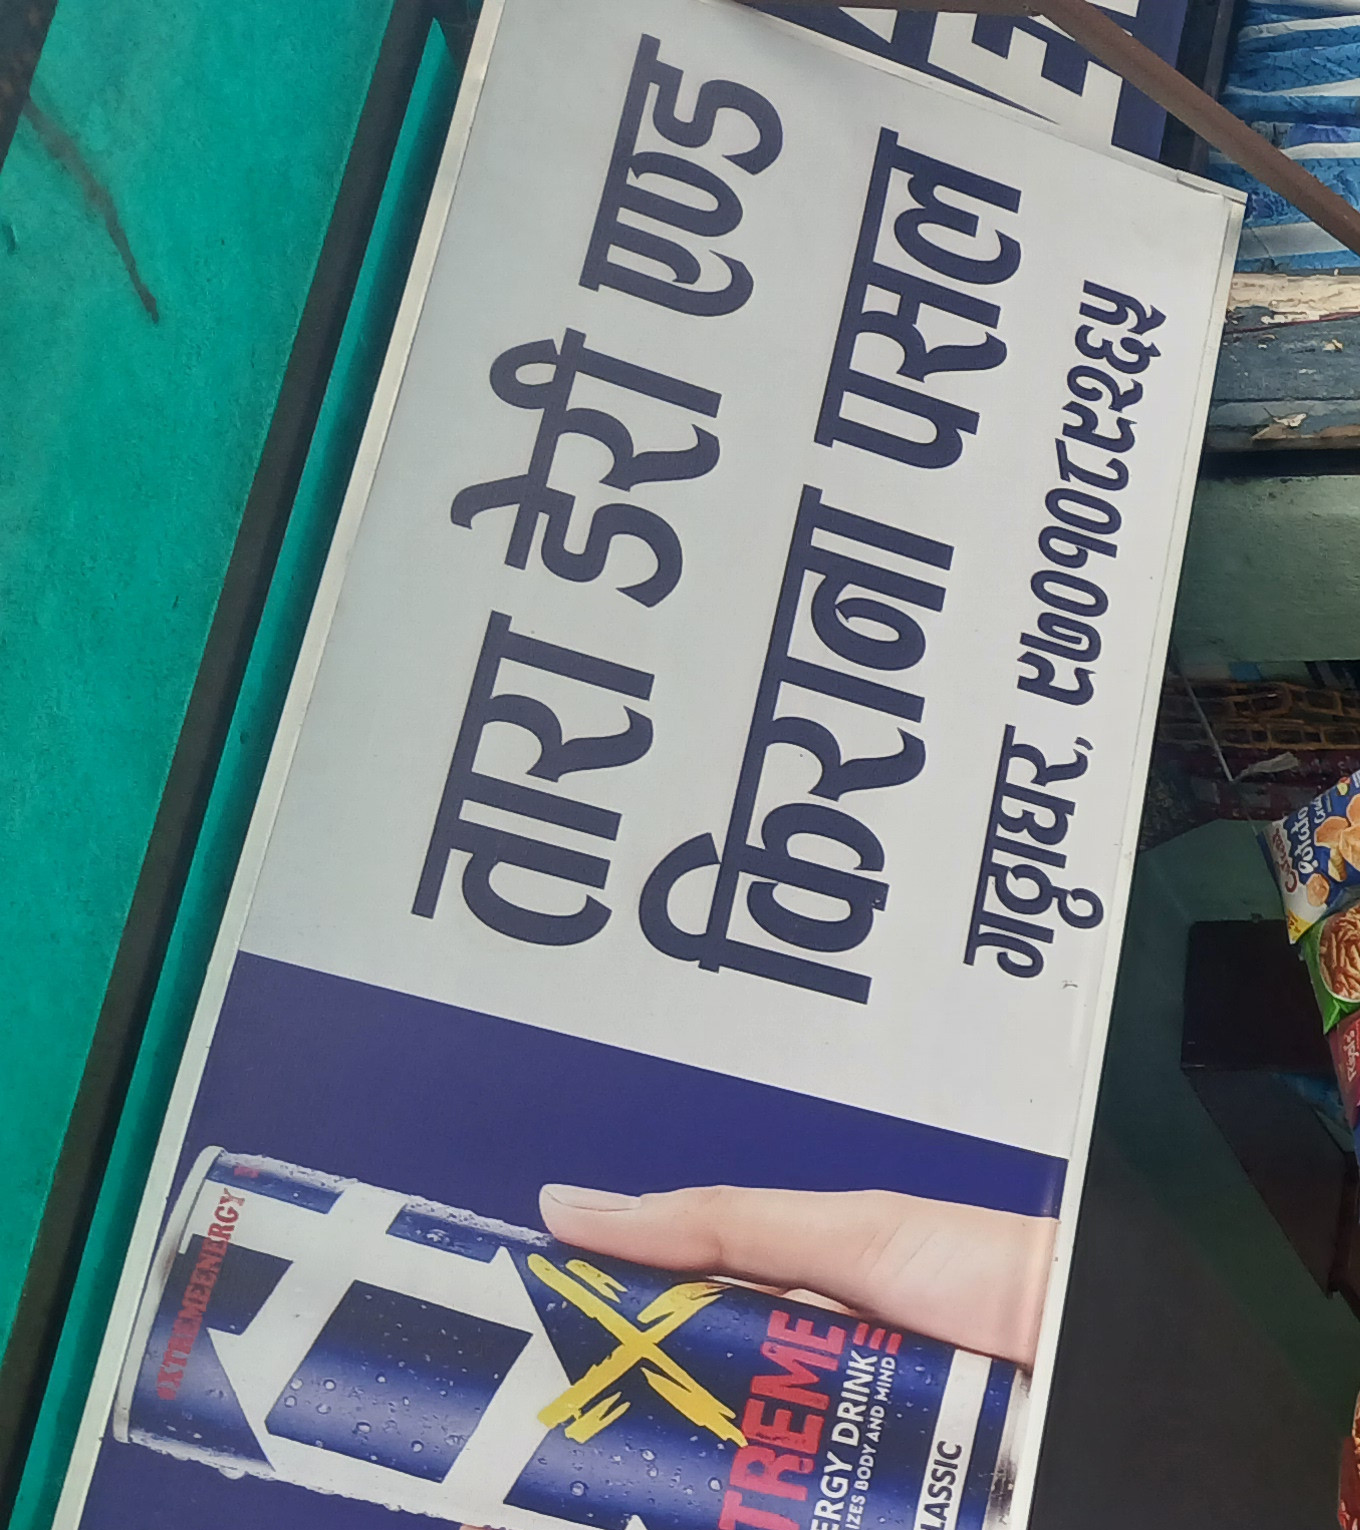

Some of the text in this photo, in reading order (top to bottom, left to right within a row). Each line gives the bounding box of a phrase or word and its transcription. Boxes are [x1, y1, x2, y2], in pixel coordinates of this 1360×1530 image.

[410, 34, 783, 948] तारा डेरी एण्ड
[637, 484, 955, 1005] किराना
[813, 127, 1022, 470] पसल
[1271, 828, 1298, 893] Current
[1290, 806, 1318, 874] Potato
[831, 1350, 878, 1447] DRINK
[875, 1356, 897, 1400] MIND
[867, 1406, 886, 1443] AND
[853, 1444, 877, 1491] BODY
